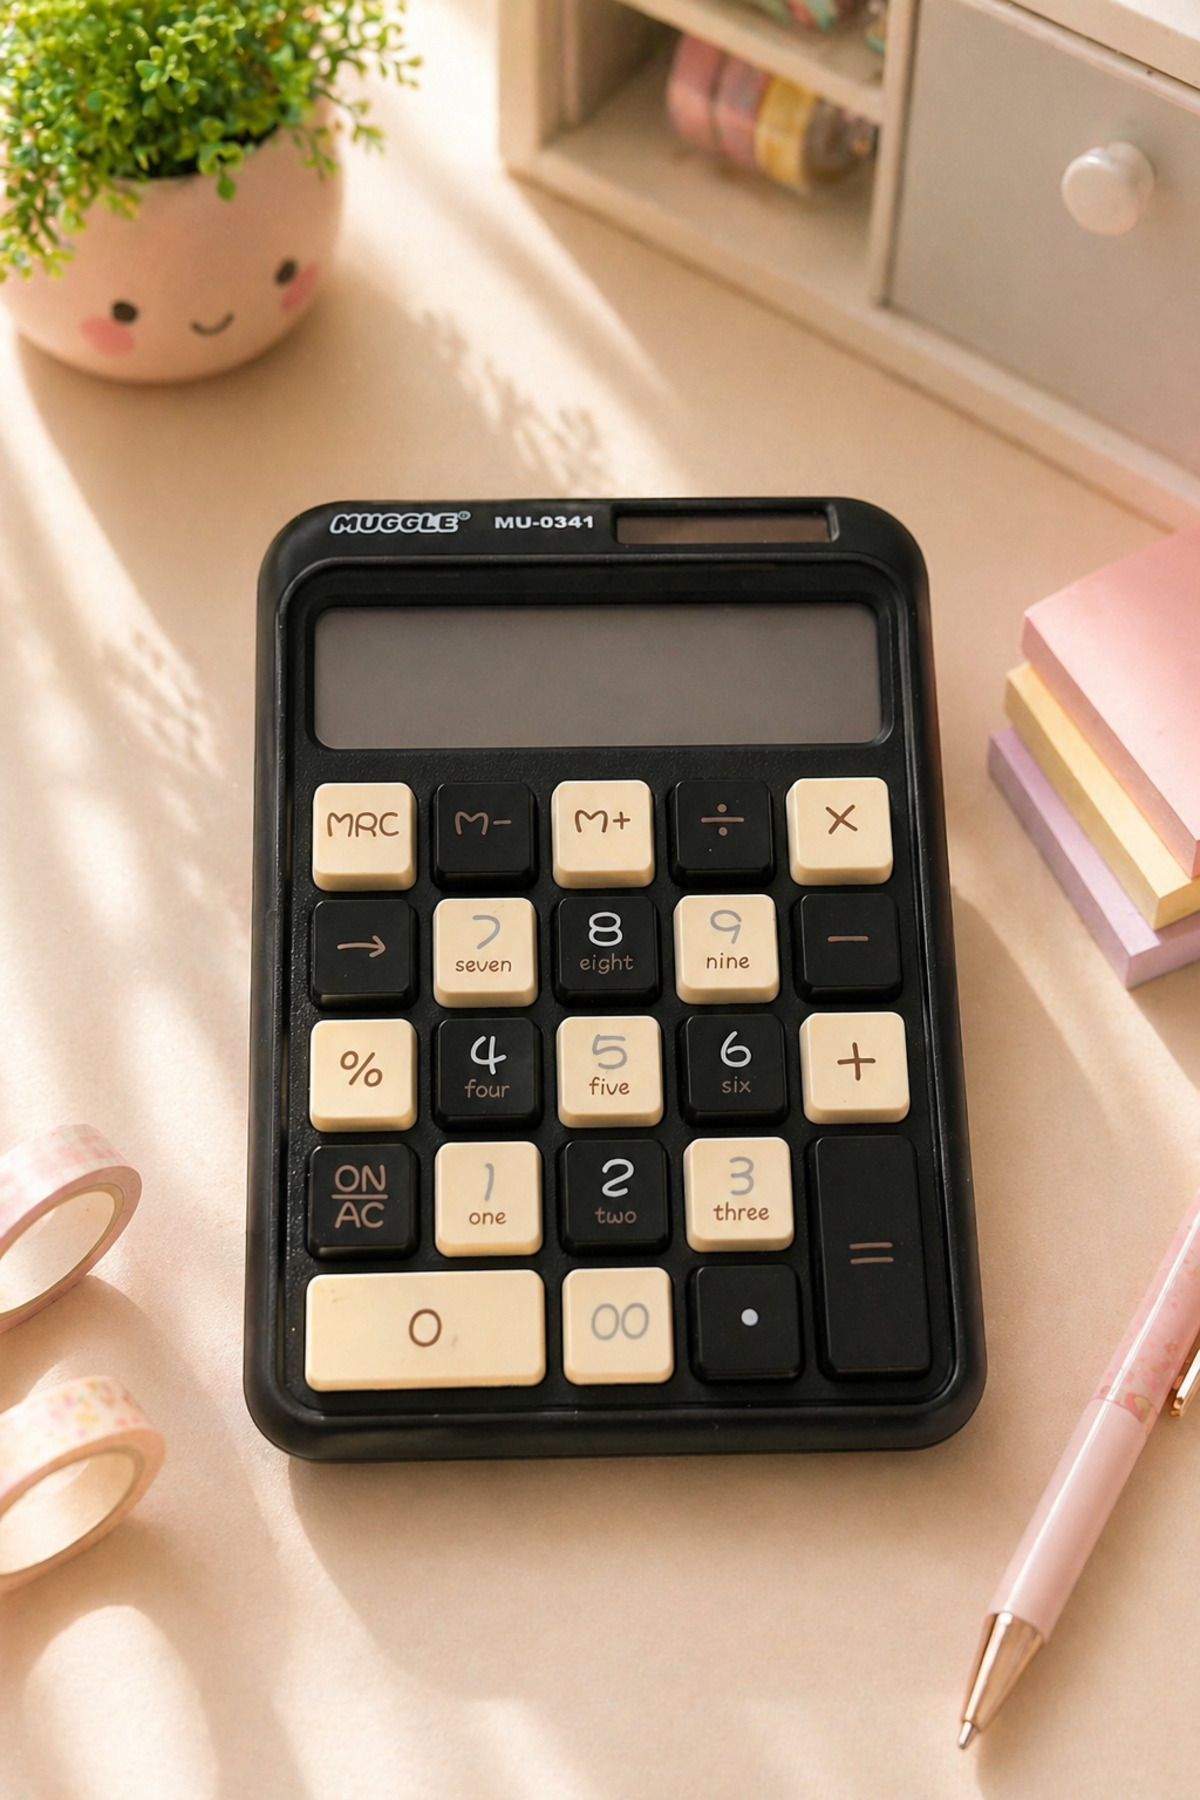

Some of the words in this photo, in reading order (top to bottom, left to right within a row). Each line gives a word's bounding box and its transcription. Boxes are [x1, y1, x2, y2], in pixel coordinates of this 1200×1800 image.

[494, 515, 594, 529] MU-0341
[326, 811, 400, 838] MRC
[574, 809, 631, 834] M+
[471, 914, 501, 950] 7
[588, 911, 623, 947] 8
[709, 909, 743, 945] 9
[455, 959, 512, 973] seven
[579, 952, 634, 975] eight
[706, 956, 750, 970] nine
[470, 1035, 507, 1076] 4
[591, 1033, 628, 1071] 5
[720, 1030, 752, 1068] 6
[339, 1050, 383, 1088] %
[464, 1078, 511, 1099] four
[588, 1076, 630, 1096] five
[721, 1075, 751, 1094] six
[334, 1164, 386, 1193] ON
[484, 1162, 495, 1202] 1
[601, 1158, 635, 1198] 2
[729, 1156, 755, 1196] 3
[334, 1201, 385, 1229] AC
[468, 1211, 507, 1226] one
[594, 1207, 637, 1224] two
[713, 1201, 770, 1222] three
